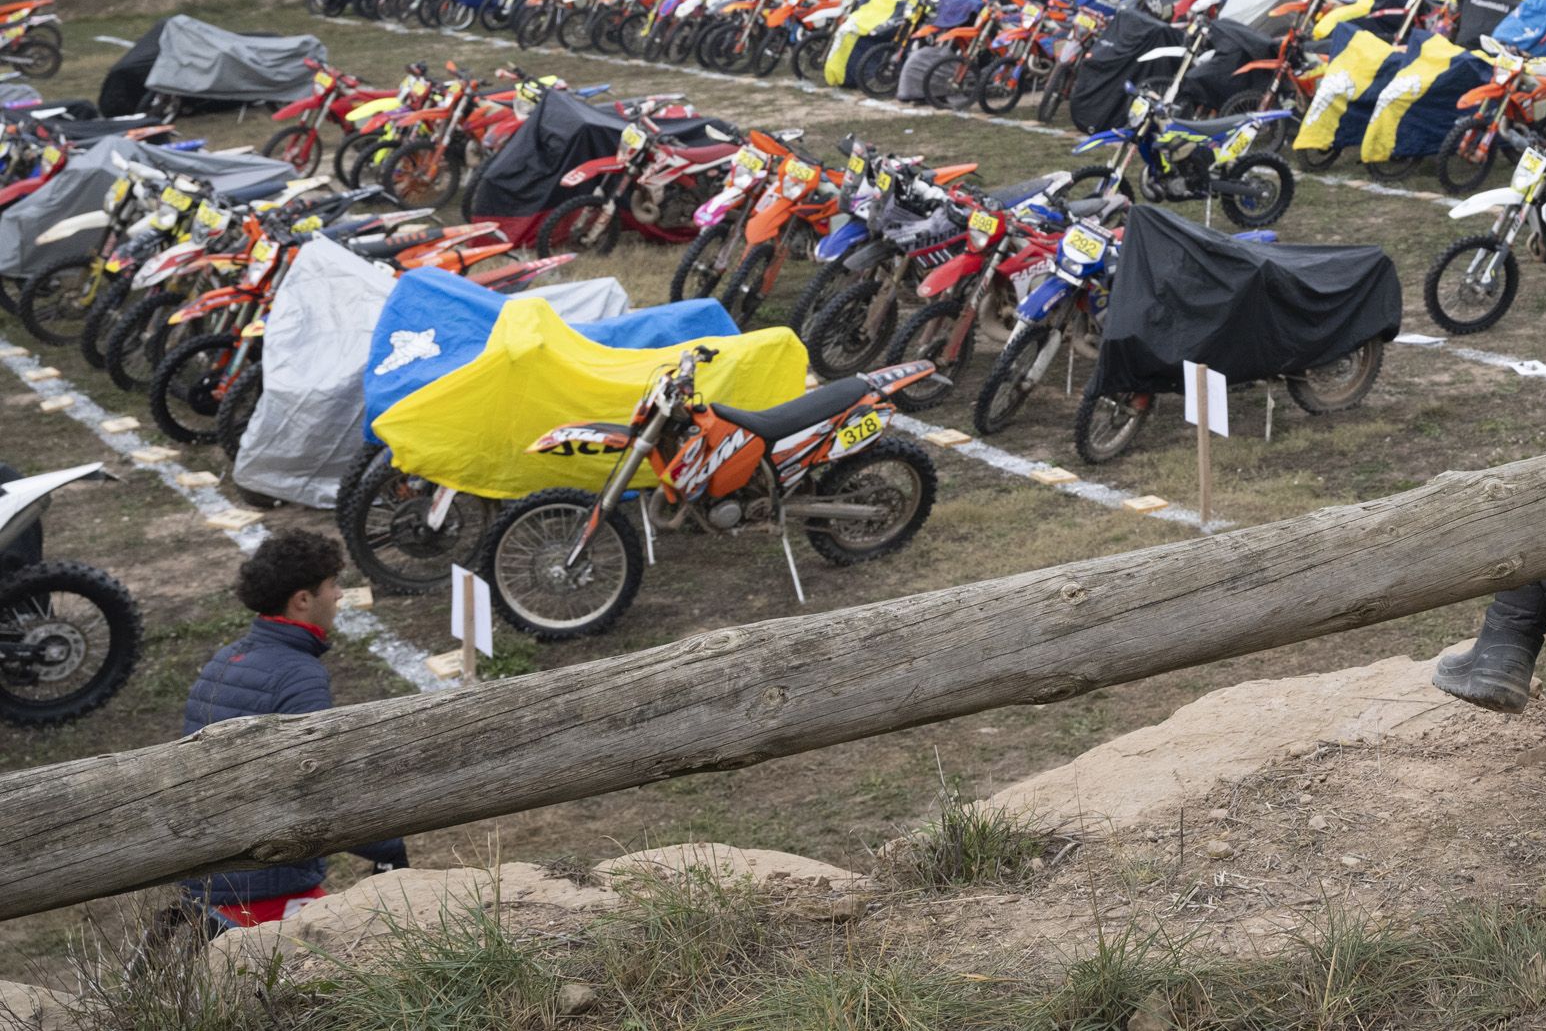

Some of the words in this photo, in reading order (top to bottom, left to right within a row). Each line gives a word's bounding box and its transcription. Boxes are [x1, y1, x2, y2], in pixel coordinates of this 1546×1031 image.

[971, 213, 994, 233] 598
[1069, 233, 1098, 254] 292
[841, 416, 879, 447] 378
